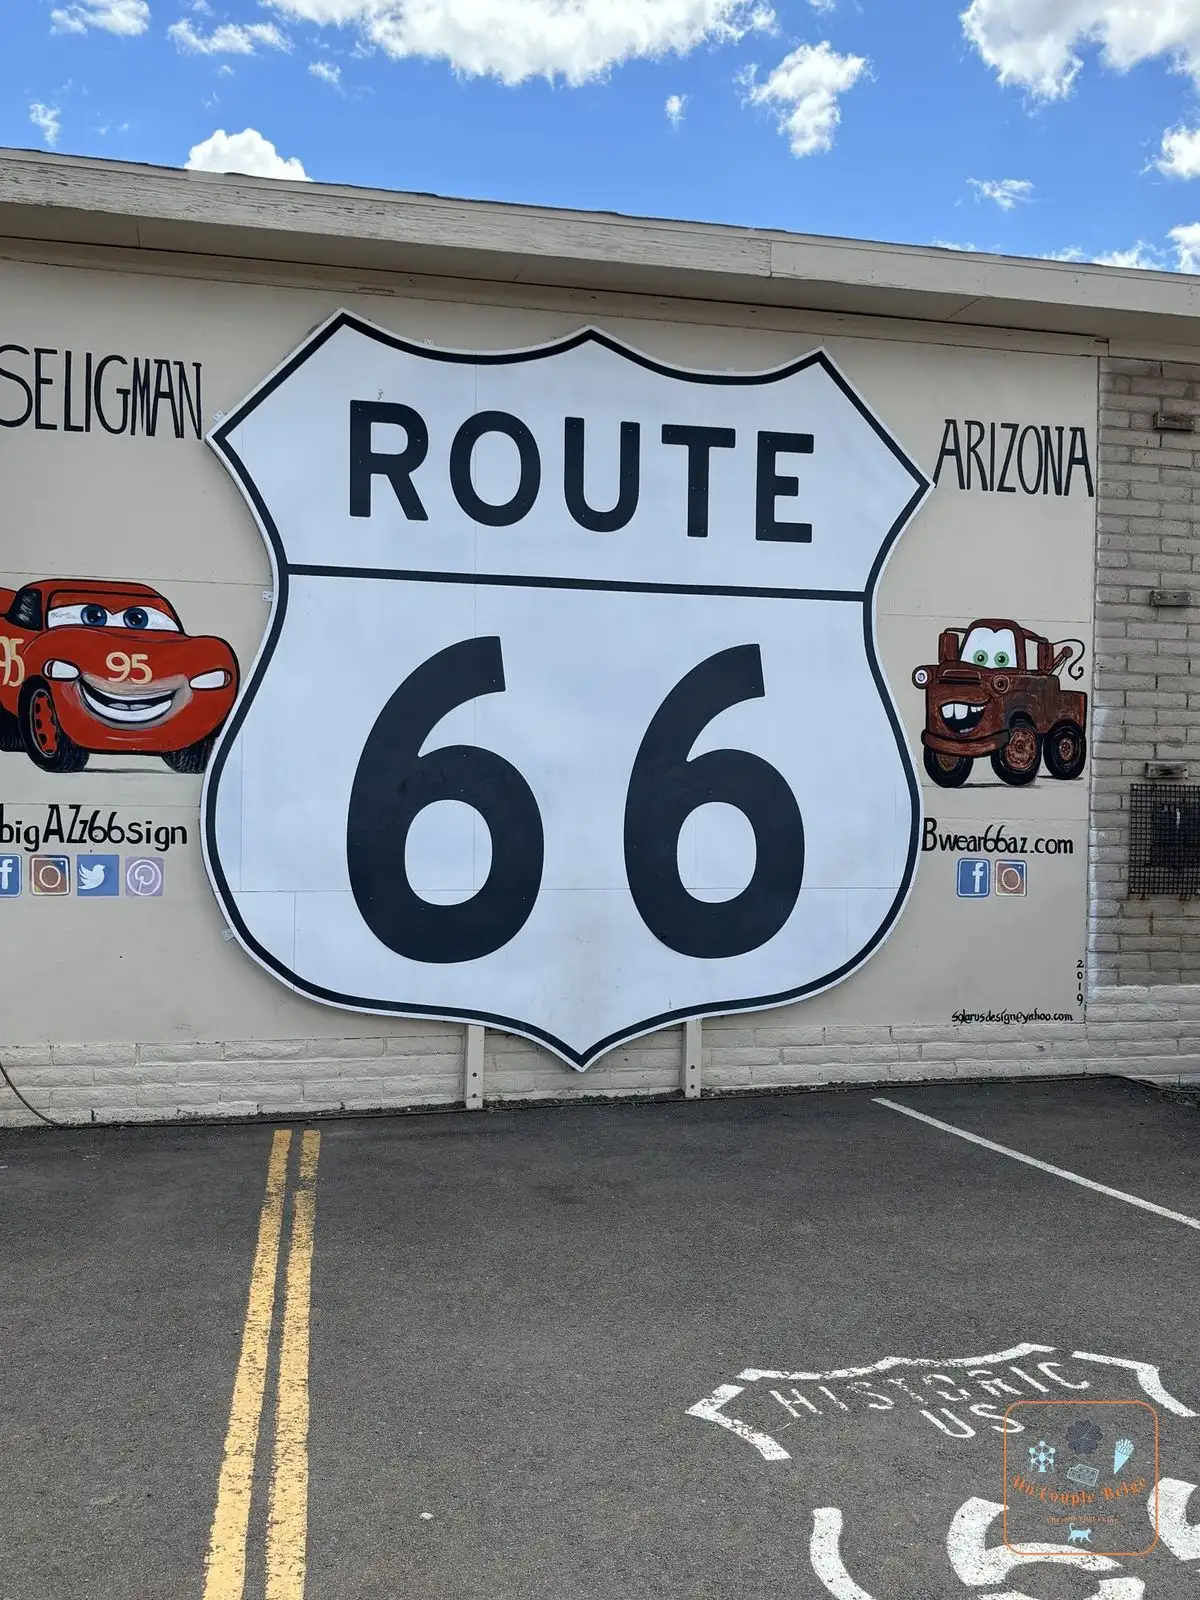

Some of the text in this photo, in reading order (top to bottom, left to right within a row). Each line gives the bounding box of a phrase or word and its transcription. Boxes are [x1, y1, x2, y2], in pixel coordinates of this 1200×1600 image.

[0, 344, 202, 440] SELIGMAN
[350, 400, 814, 543] ROUTE
[933, 419, 1094, 497] ARIZONA
[106, 651, 152, 684] 95
[347, 636, 805, 964] 66
[922, 817, 1073, 855] Bwear66az.com
[1076, 959, 1084, 1006] 2019
[770, 1361, 1090, 1417] HISTORIC
[919, 1403, 1026, 1438] US
